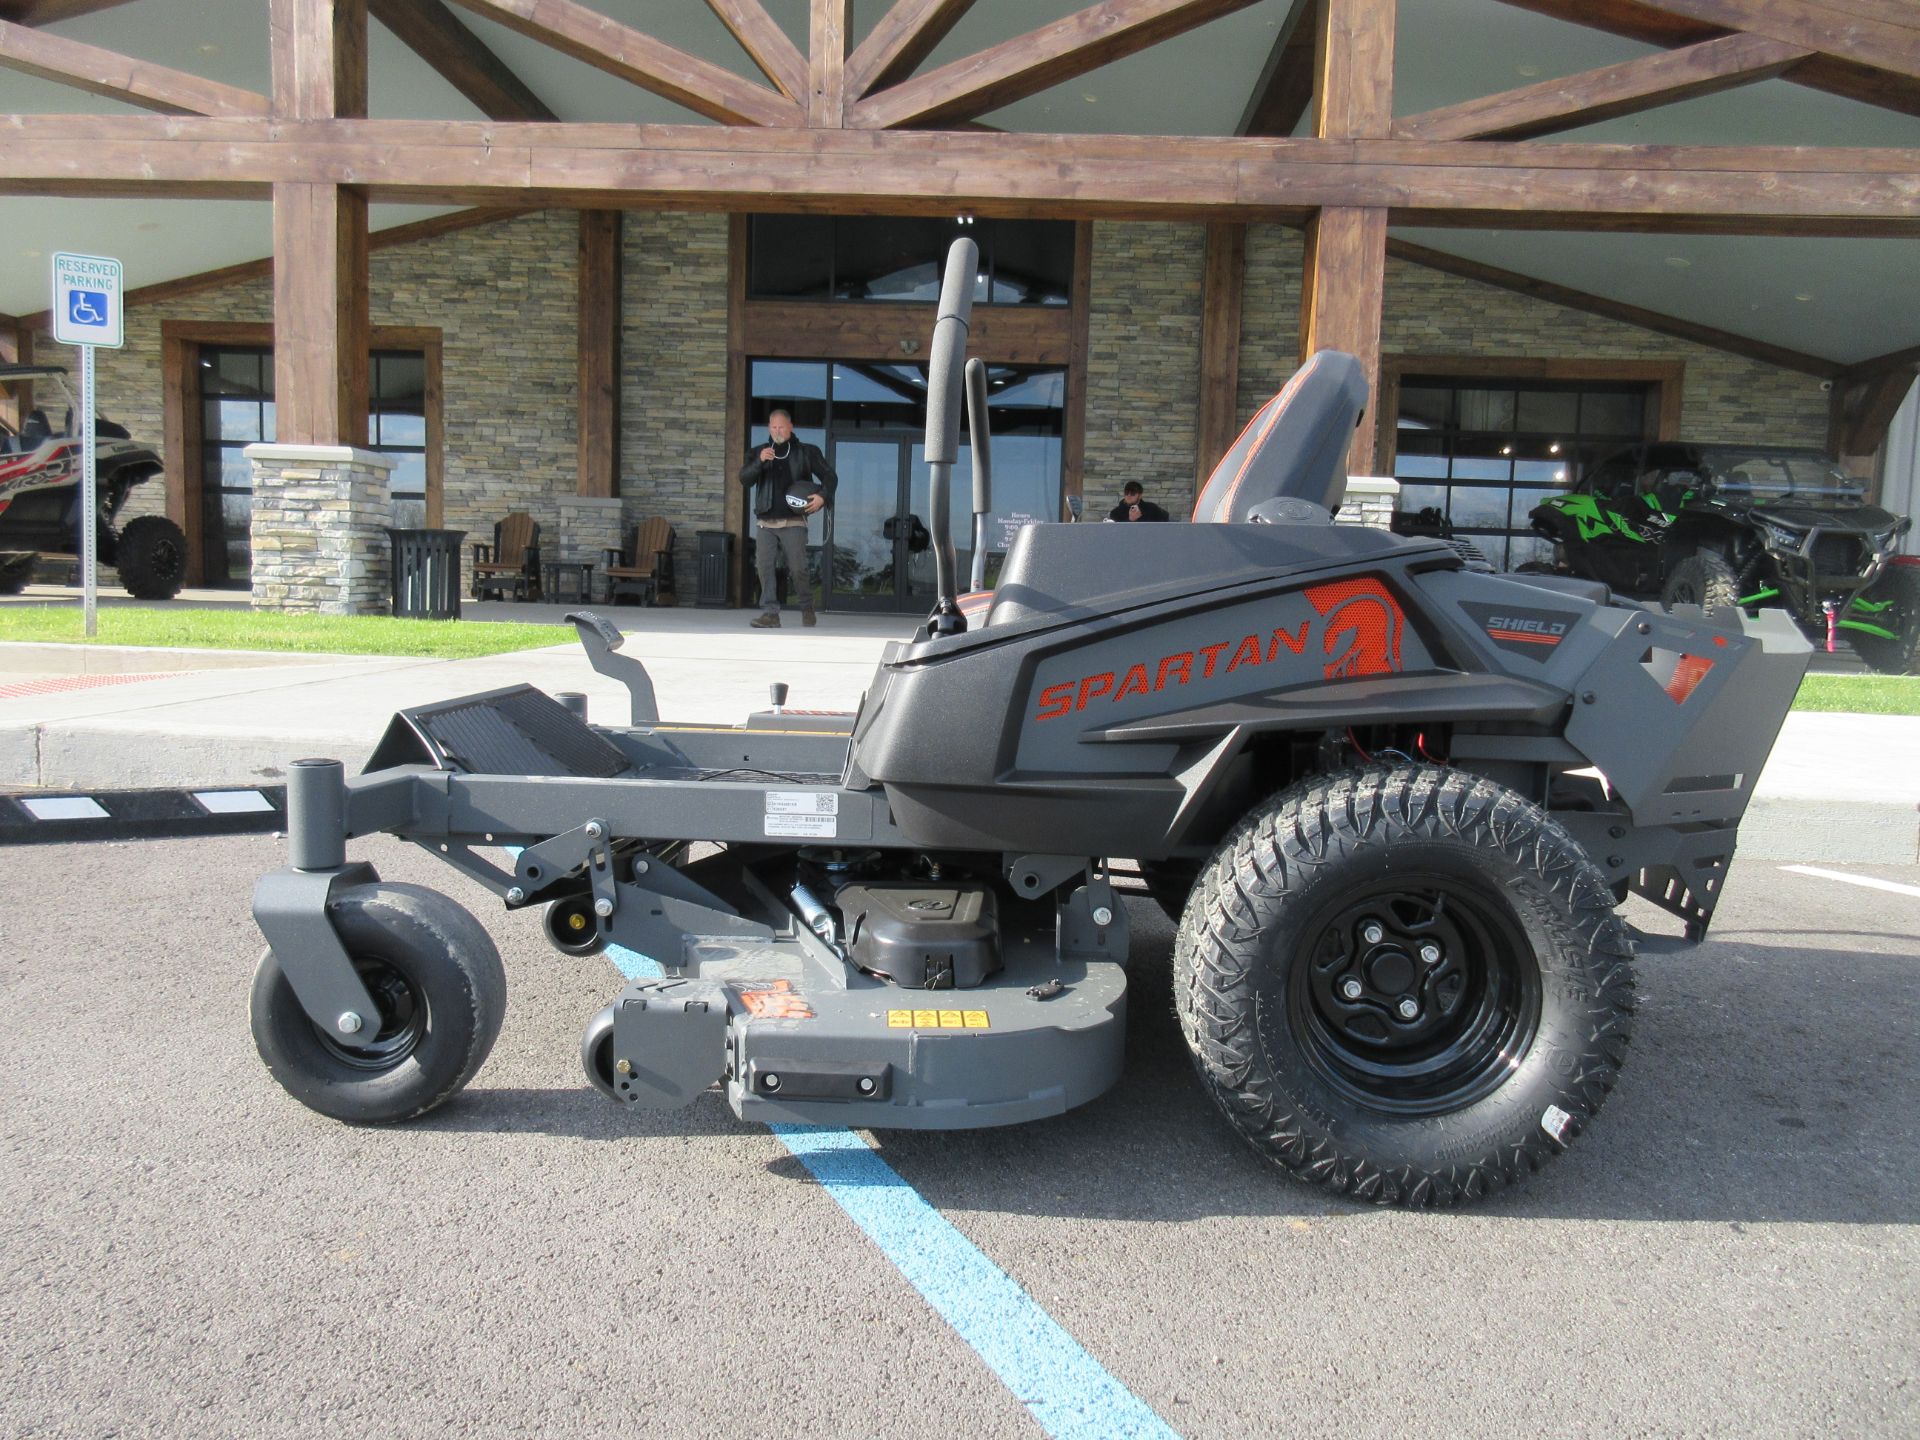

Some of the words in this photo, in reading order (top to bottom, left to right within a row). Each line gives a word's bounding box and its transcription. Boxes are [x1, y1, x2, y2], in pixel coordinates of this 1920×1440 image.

[58, 258, 118, 277] RESERVED
[63, 274, 113, 290] PARKING
[1487, 616, 1568, 635] SHIELD
[1035, 620, 1311, 721] SPARTAN
